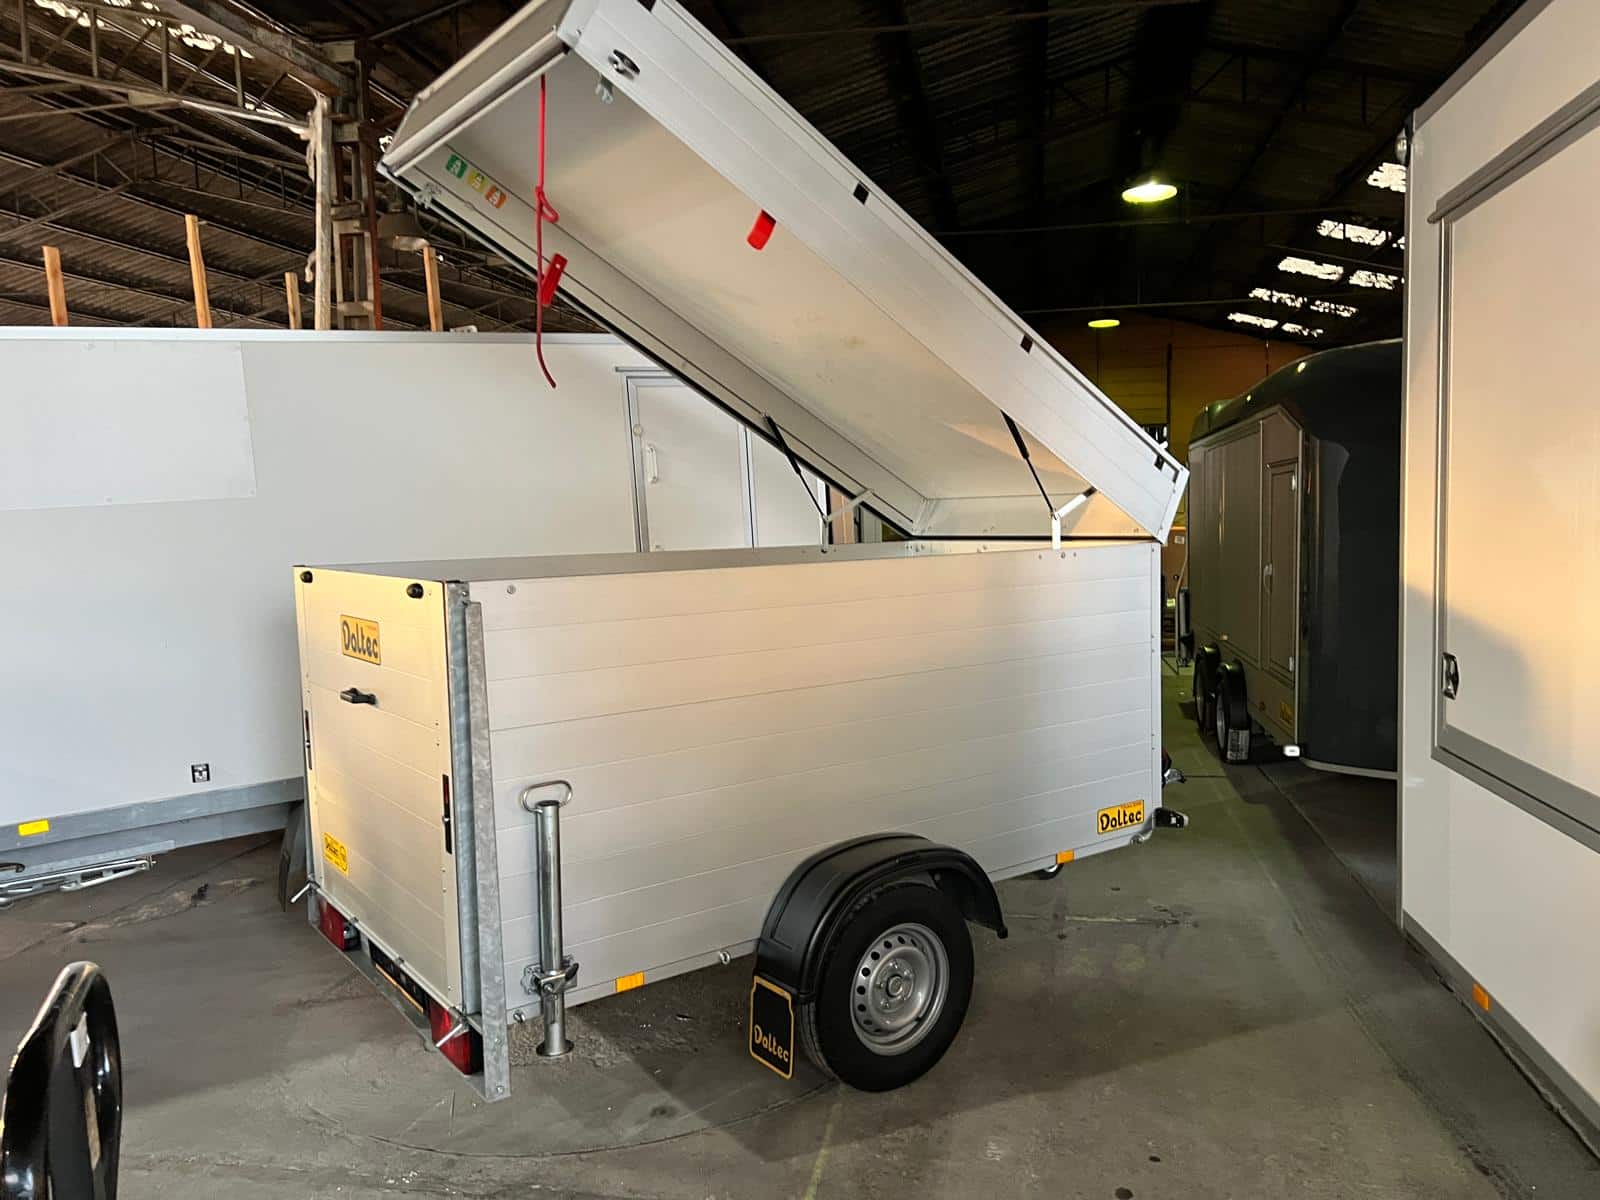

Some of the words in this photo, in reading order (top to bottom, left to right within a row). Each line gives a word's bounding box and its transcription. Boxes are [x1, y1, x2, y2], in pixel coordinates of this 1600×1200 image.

[343, 620, 378, 659] Doltec
[1100, 808, 1141, 830] Doltec
[754, 1024, 789, 1062] Doltec
